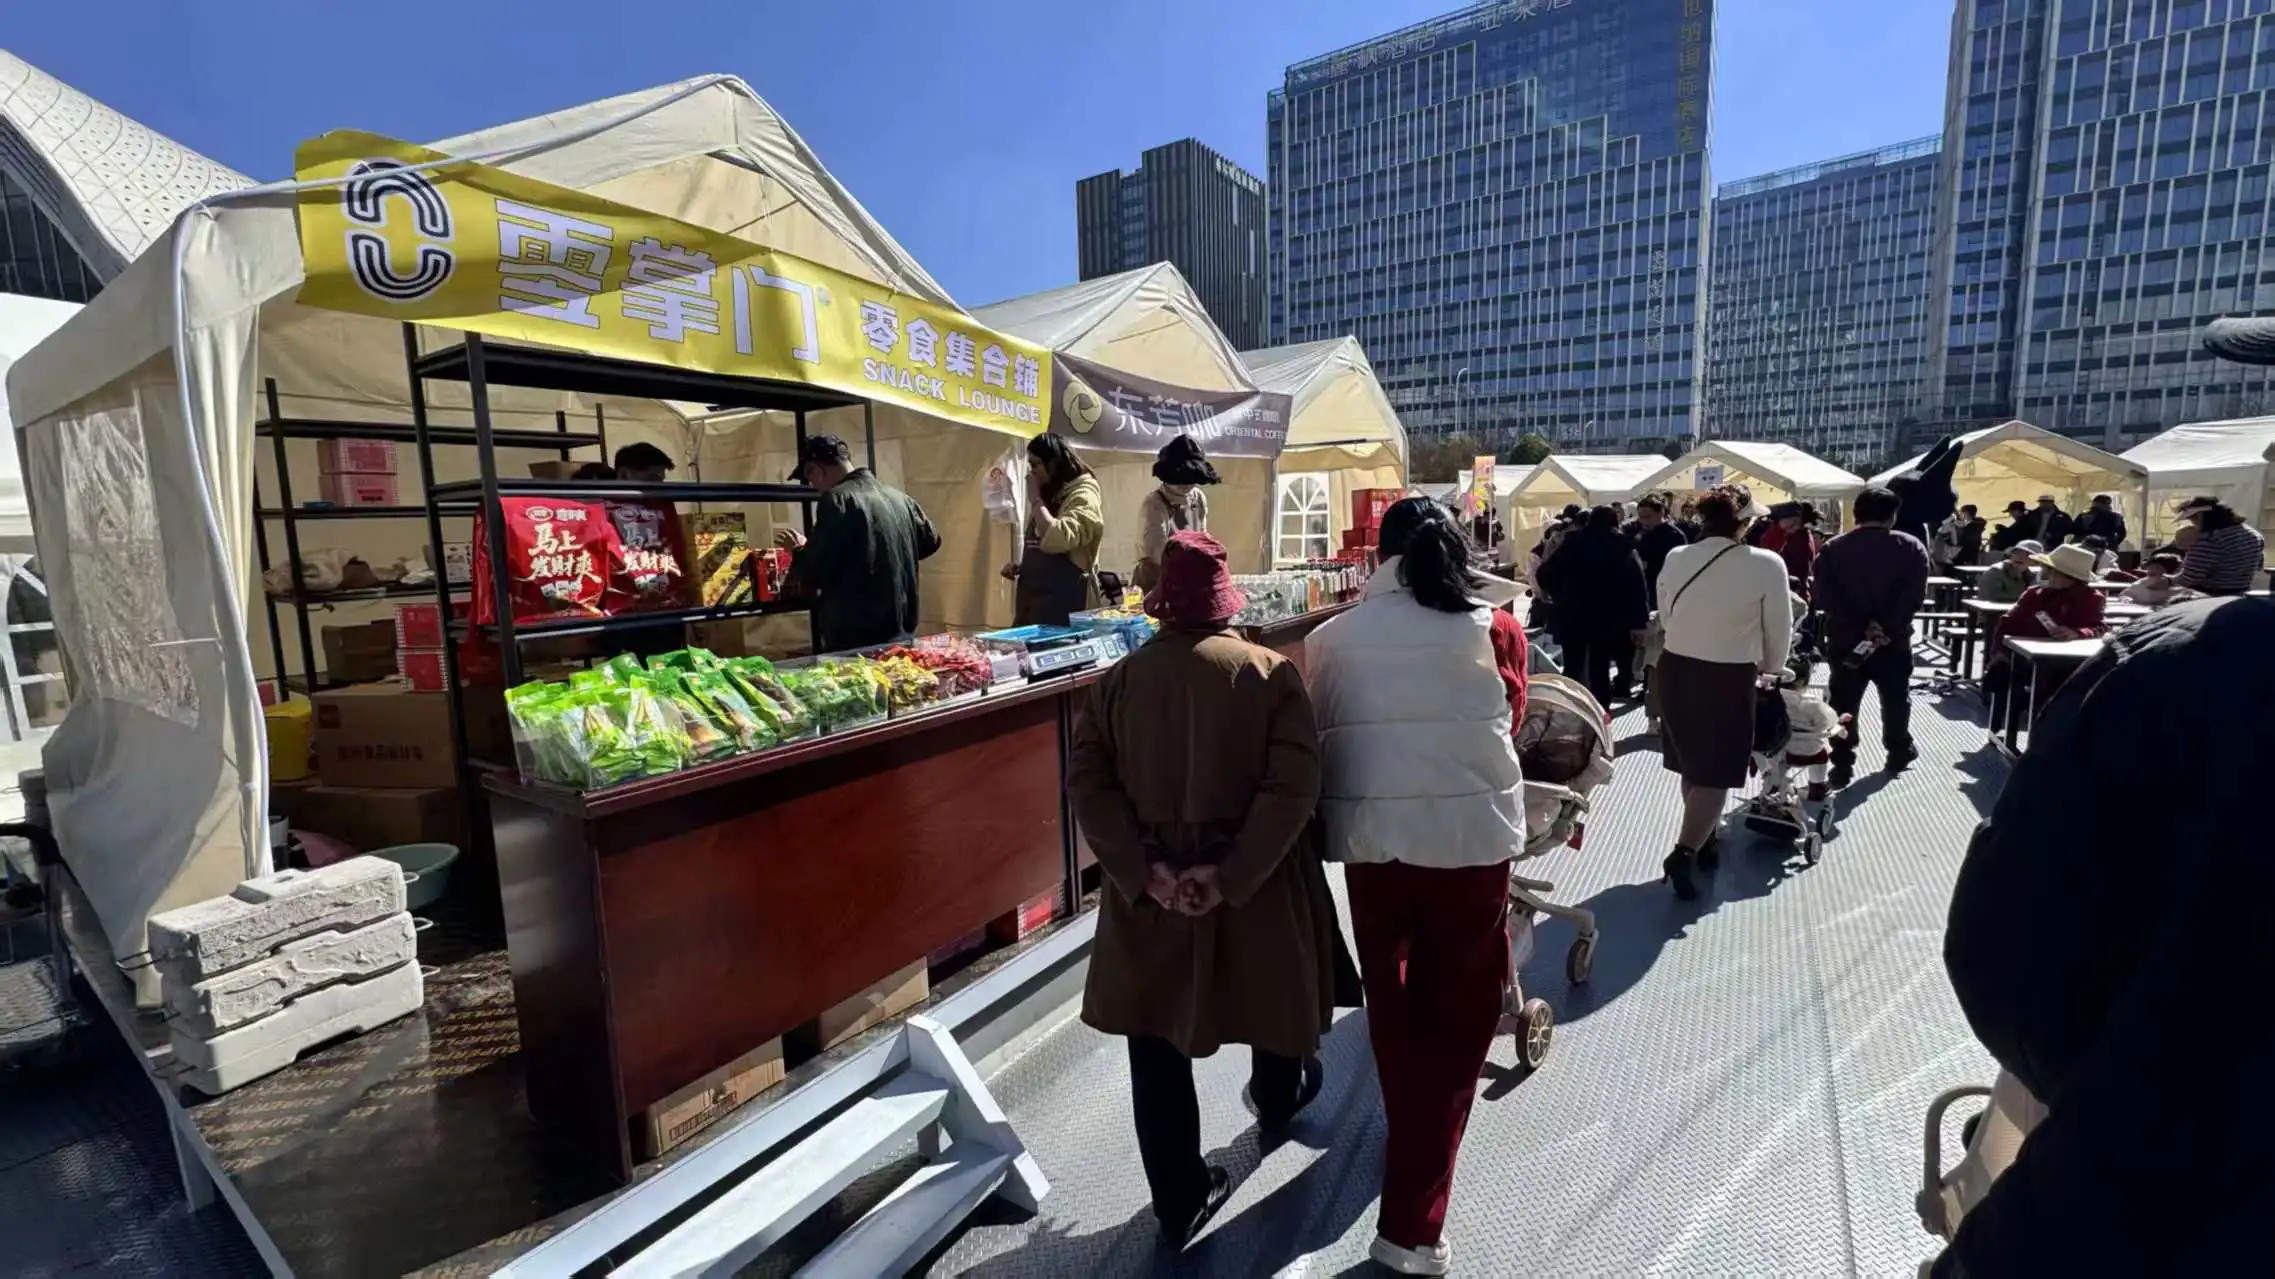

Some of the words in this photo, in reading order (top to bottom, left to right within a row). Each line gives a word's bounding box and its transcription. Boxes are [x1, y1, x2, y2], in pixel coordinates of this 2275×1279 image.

[495, 199, 821, 365] 零掌门
[860, 300, 1041, 399] 零食集合铺
[862, 356, 946, 402] SNACK
[958, 387, 1042, 425] LOUNGE
